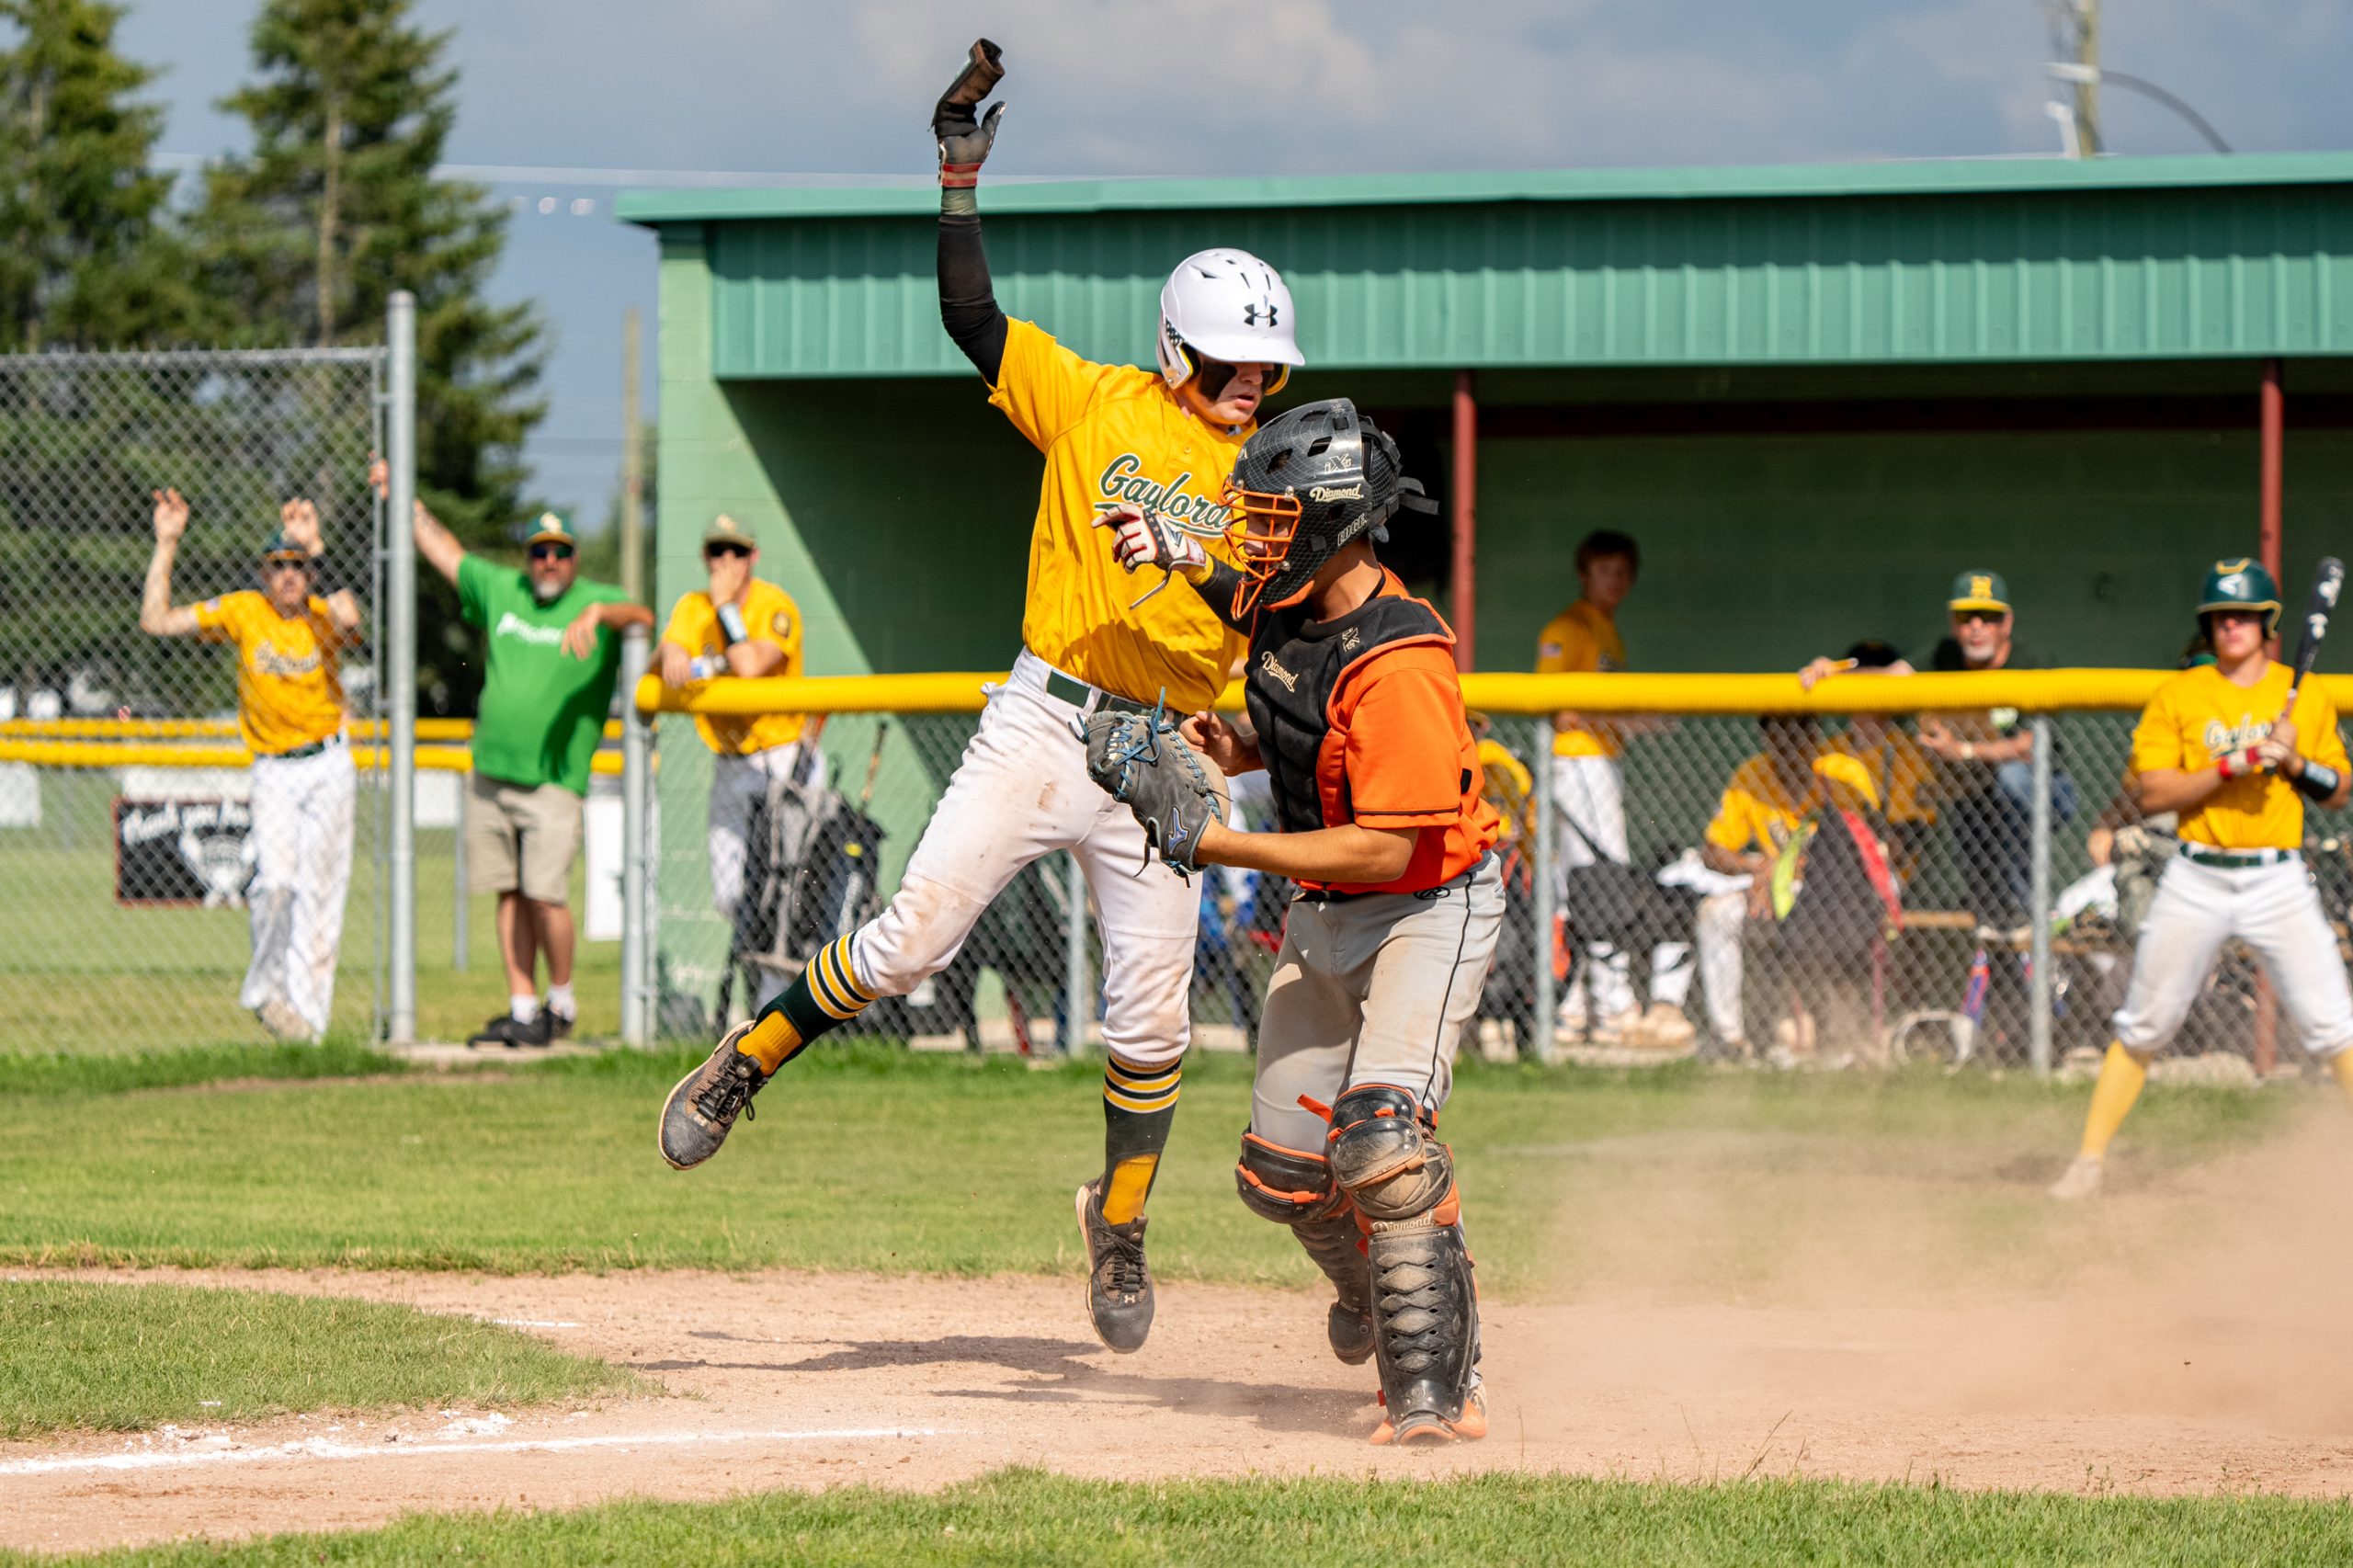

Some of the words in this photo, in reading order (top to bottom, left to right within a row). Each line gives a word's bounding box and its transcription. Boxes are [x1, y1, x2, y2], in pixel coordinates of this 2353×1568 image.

[1309, 483, 1362, 502] Diamond
[1336, 512, 1366, 547] EDGE
[1261, 651, 1299, 693] Diamond
[1371, 1209, 1434, 1233] Diamond
